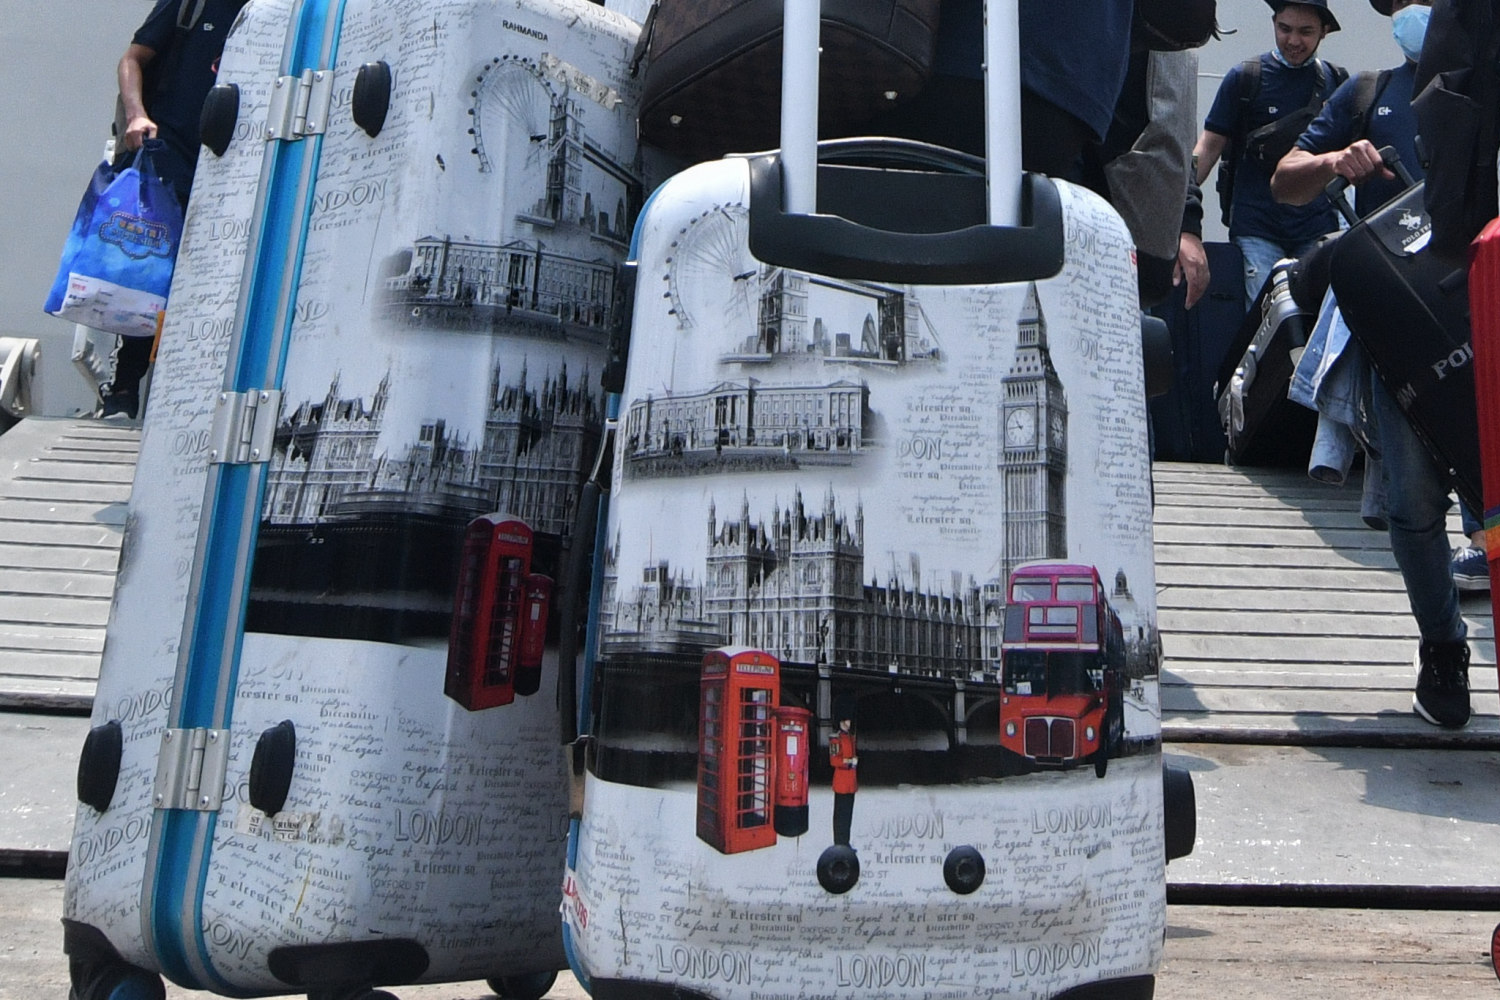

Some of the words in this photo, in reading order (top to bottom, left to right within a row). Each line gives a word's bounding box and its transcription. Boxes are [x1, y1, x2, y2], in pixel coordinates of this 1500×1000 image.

[502, 19, 549, 42] RAHMANDA
[311, 178, 388, 216] NDON
[907, 515, 955, 525] Leicester
[319, 707, 380, 721] Piccadilly
[342, 743, 383, 759] Regent
[351, 769, 397, 783] OXFORD
[401, 776, 413, 785] ST
[403, 761, 445, 780] Regent
[1031, 802, 1113, 834] LONDON
[394, 807, 483, 847] LONDON
[347, 841, 393, 861] Regent
[992, 840, 1034, 855] Regent
[875, 852, 925, 865] Leicester
[414, 860, 460, 874] Leicester
[1014, 865, 1053, 875] OXFORD
[1056, 863, 1068, 872] ST
[374, 879, 411, 889] OXFORD
[415, 882, 426, 890] ST
[615, 908, 656, 922] OXFORD
[659, 914, 672, 924] ST
[660, 901, 703, 917] Regent
[730, 909, 781, 922] Leicester
[1020, 907, 1063, 923] Regent
[843, 914, 883, 928] Regent
[674, 918, 719, 938] Oxford
[750, 922, 796, 933] Piccadilly
[801, 926, 837, 935] OXFORD
[841, 926, 852, 934] ST
[855, 926, 896, 943] Oxford
[976, 922, 1014, 931] OXFORD
[1017, 920, 1029, 929] ST
[1031, 918, 1073, 936] Oxford
[656, 944, 751, 986] LONDON
[1011, 936, 1101, 978] LONDON
[836, 953, 927, 989] LONDON
